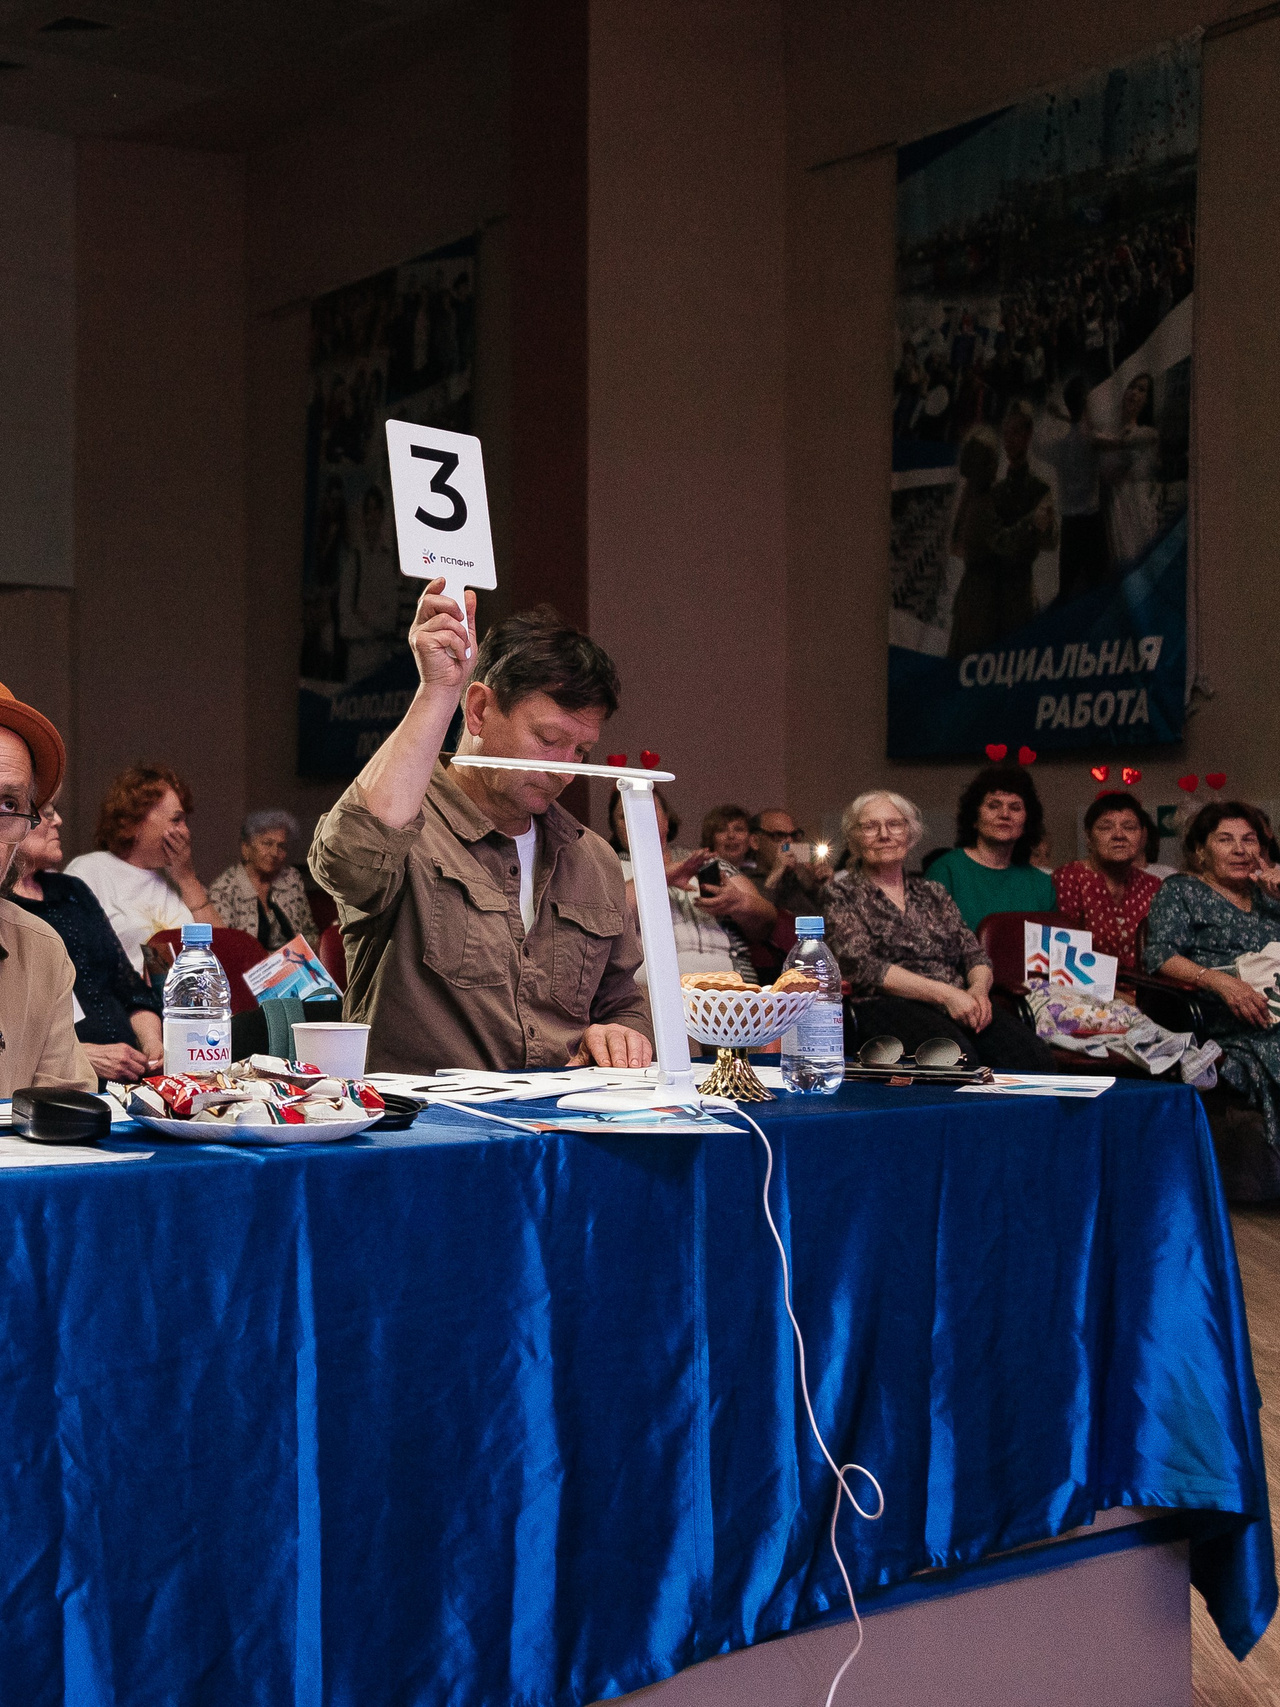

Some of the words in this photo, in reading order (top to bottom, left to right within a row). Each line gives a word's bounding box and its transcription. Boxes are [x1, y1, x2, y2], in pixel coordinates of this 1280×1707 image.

[410, 444, 468, 532] 3
[440, 556, 475, 568] ПСПФНР
[959, 635, 1164, 689] СОЦИАЛЬНАЯ
[1035, 688, 1150, 729] РАБОТА
[187, 1048, 231, 1062] TASSAY
